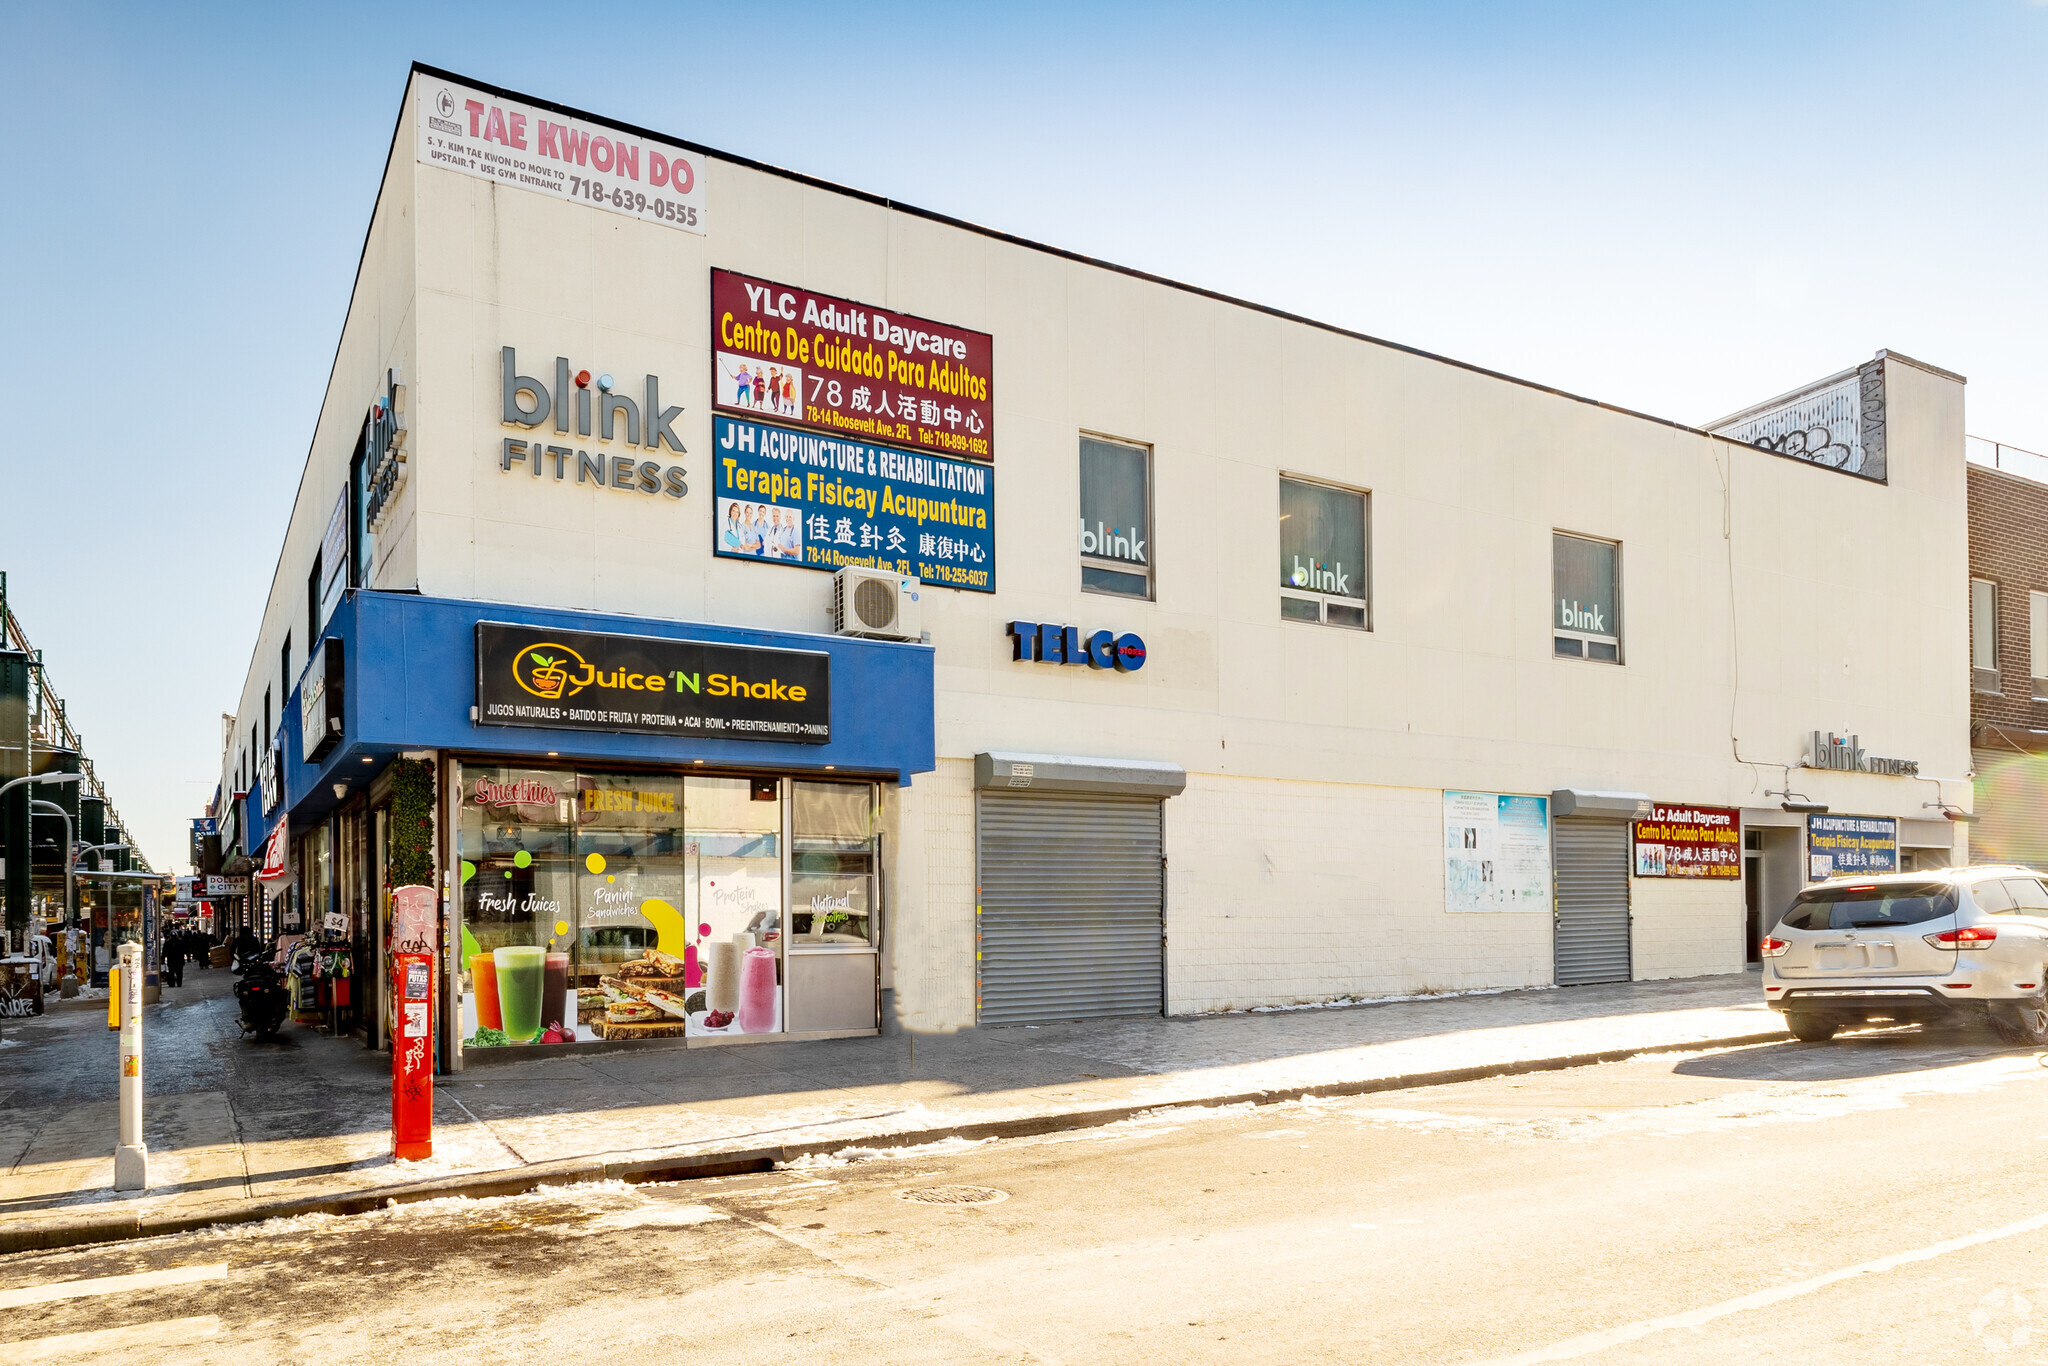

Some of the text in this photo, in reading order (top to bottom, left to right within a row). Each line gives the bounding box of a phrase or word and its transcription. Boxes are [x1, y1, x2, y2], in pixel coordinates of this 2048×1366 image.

[428, 136, 436, 146] S.
[448, 142, 464, 154] KIM
[467, 147, 482, 158] TAE
[484, 152, 512, 167] KWON
[514, 159, 526, 170] DO
[528, 164, 552, 177] MOVE
[554, 170, 564, 180] TO
[464, 99, 694, 194] TAE KWON DO
[431, 150, 562, 192] UPSTAIR. USE GYM ENTRANCE
[569, 176, 697, 227] 718-639-0555
[744, 282, 966, 360] YLC Adult Daycare
[721, 312, 986, 401] Centro De Cuidado Para Adultos
[501, 346, 688, 456] blink
[808, 374, 843, 407] 78
[806, 405, 912, 440] 78-14 Roosevelt Ave. 2FL
[850, 386, 984, 434] 成人活動中心
[918, 428, 988, 454] Tel: 718-899-1692
[502, 438, 688, 498] FITNESS
[720, 423, 984, 495] JH ACUPUNCTURE & REHABILITATION
[722, 458, 986, 529] Terapia Fisicay Acupuntura
[806, 514, 907, 554] 佳盛針灸
[918, 533, 986, 563] 康復中心
[1080, 518, 1146, 562] blink
[806, 546, 831, 565] 78-14
[833, 551, 875, 568] Roosevelt
[896, 560, 912, 576] 2FL
[918, 562, 988, 586] Tel: 718-255-6037
[1293, 555, 1349, 594] blink
[1562, 599, 1604, 632] blink
[1009, 620, 1146, 672] TELCO
[568, 663, 666, 692] Juice
[706, 674, 807, 702] Shake
[487, 704, 514, 716] JUGOS
[516, 706, 560, 720] NATURALES
[570, 708, 596, 722] BATIDO
[598, 710, 608, 722] DE
[609, 712, 632, 724] FRUTA
[633, 713, 638, 724] Y
[642, 713, 676, 726] PROTEINA
[684, 716, 700, 728] ACAI
[706, 718, 726, 730] BOWL
[804, 724, 828, 736] PANINIS
[1811, 730, 1867, 771] blink
[1870, 757, 1919, 776] FITNESS
[475, 778, 556, 806] Smoothies
[584, 789, 674, 812] FRESH JUICE
[1638, 822, 1738, 843] Centro De Cuidado Para Adultos
[1648, 808, 1665, 821] LC
[1667, 809, 1692, 823] Adult
[1693, 810, 1730, 826] Daycare
[1811, 818, 1822, 829] JH
[1823, 818, 1856, 832] ACUPUNCTURE
[1860, 820, 1894, 834] REHABILITATION
[1666, 846, 1680, 860] 78
[1812, 833, 1894, 852] Terapia Fisicay Acupuntura
[478, 892, 560, 914] Fresh Juices
[586, 904, 638, 920] Sandwiches
[593, 887, 633, 906] Panini
[714, 886, 755, 906] Protein
[812, 890, 850, 914] Natural
[331, 917, 344, 928] $4
